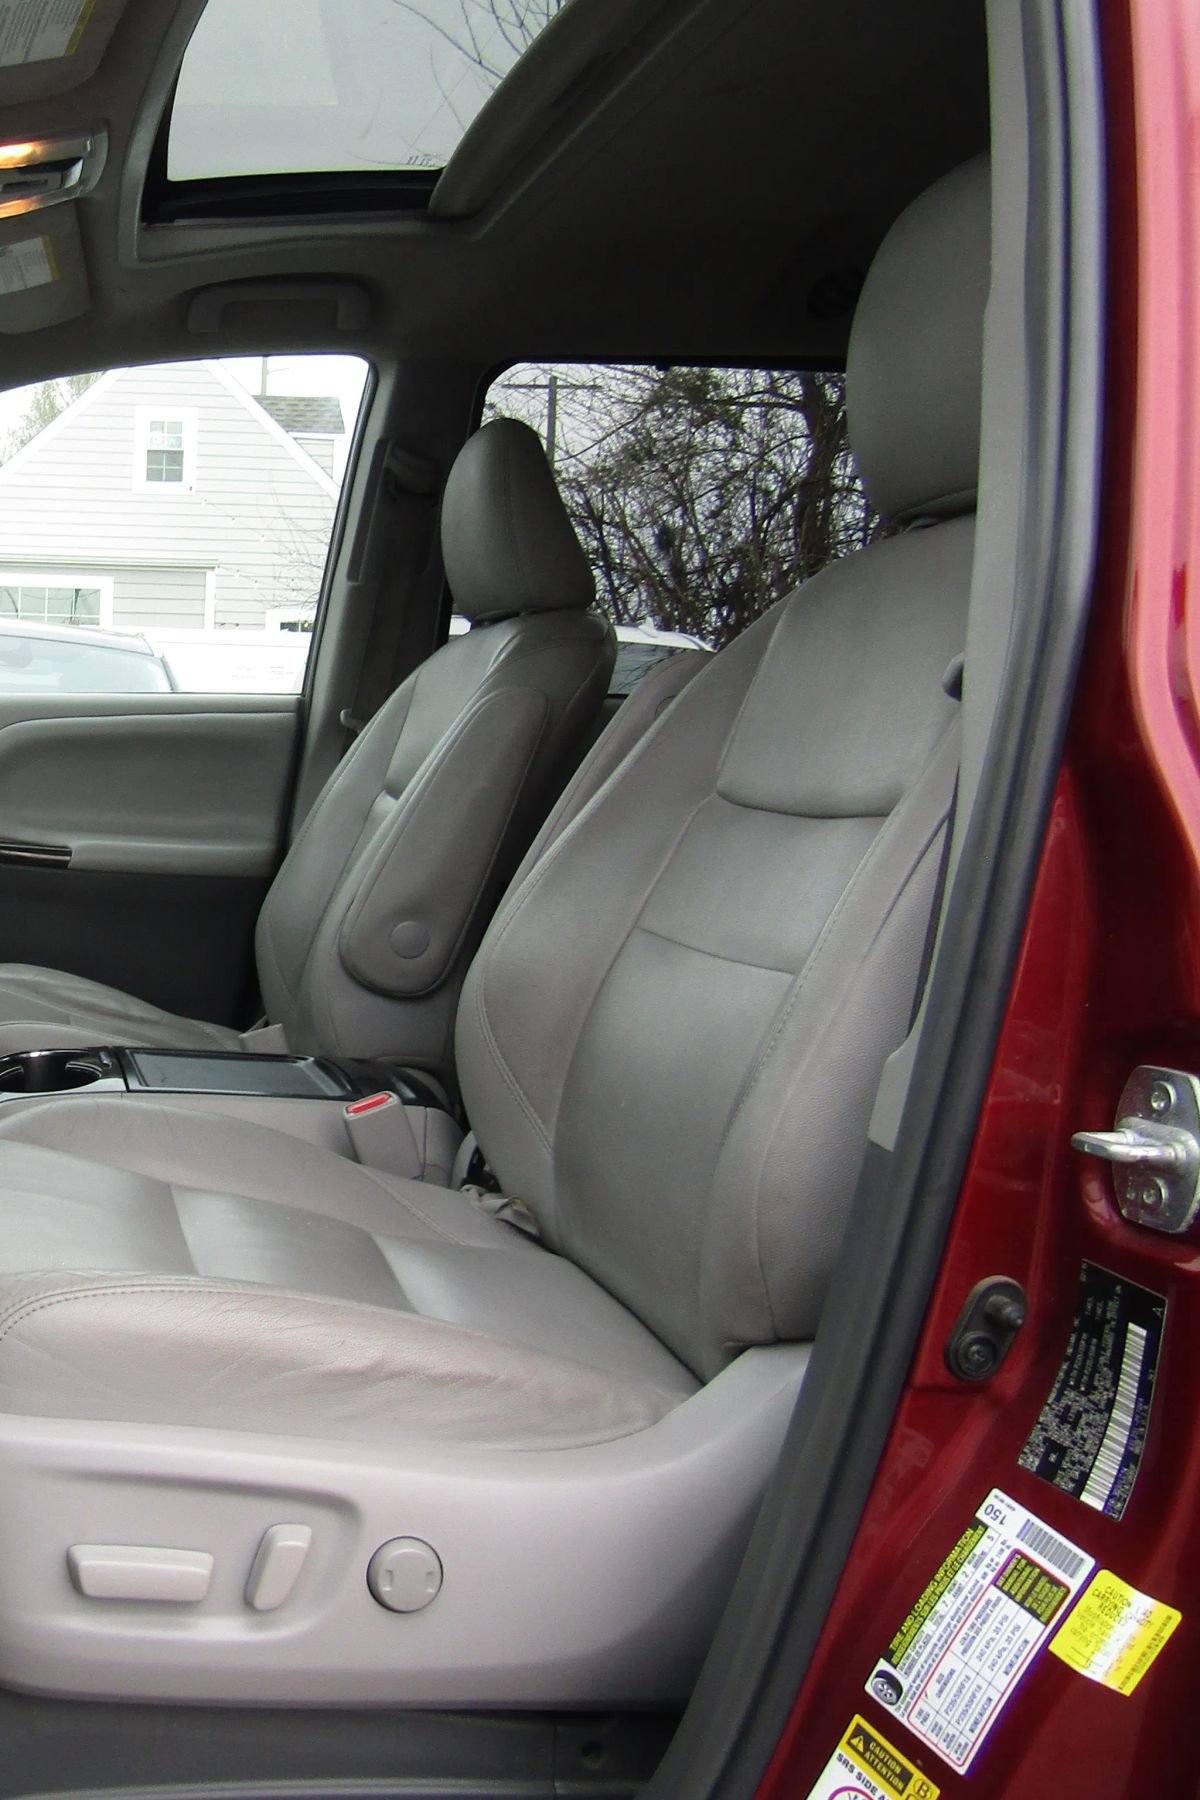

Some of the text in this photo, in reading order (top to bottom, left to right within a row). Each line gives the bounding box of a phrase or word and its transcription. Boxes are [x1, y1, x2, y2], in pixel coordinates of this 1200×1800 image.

[984, 1503, 1008, 1525] 150
[961, 1570, 969, 1578] 2
[888, 1631, 904, 1651] TIRE
[899, 1614, 915, 1633] AND
[910, 1579, 938, 1616] LOADING
[933, 1526, 974, 1582] INFORMATION
[975, 1648, 987, 1662] 240
[987, 1657, 999, 1672] 240
[864, 1751, 904, 1789] ATTENTION
[869, 1742, 901, 1774] CAUTION
[836, 1753, 878, 1796] SRS SIDE
